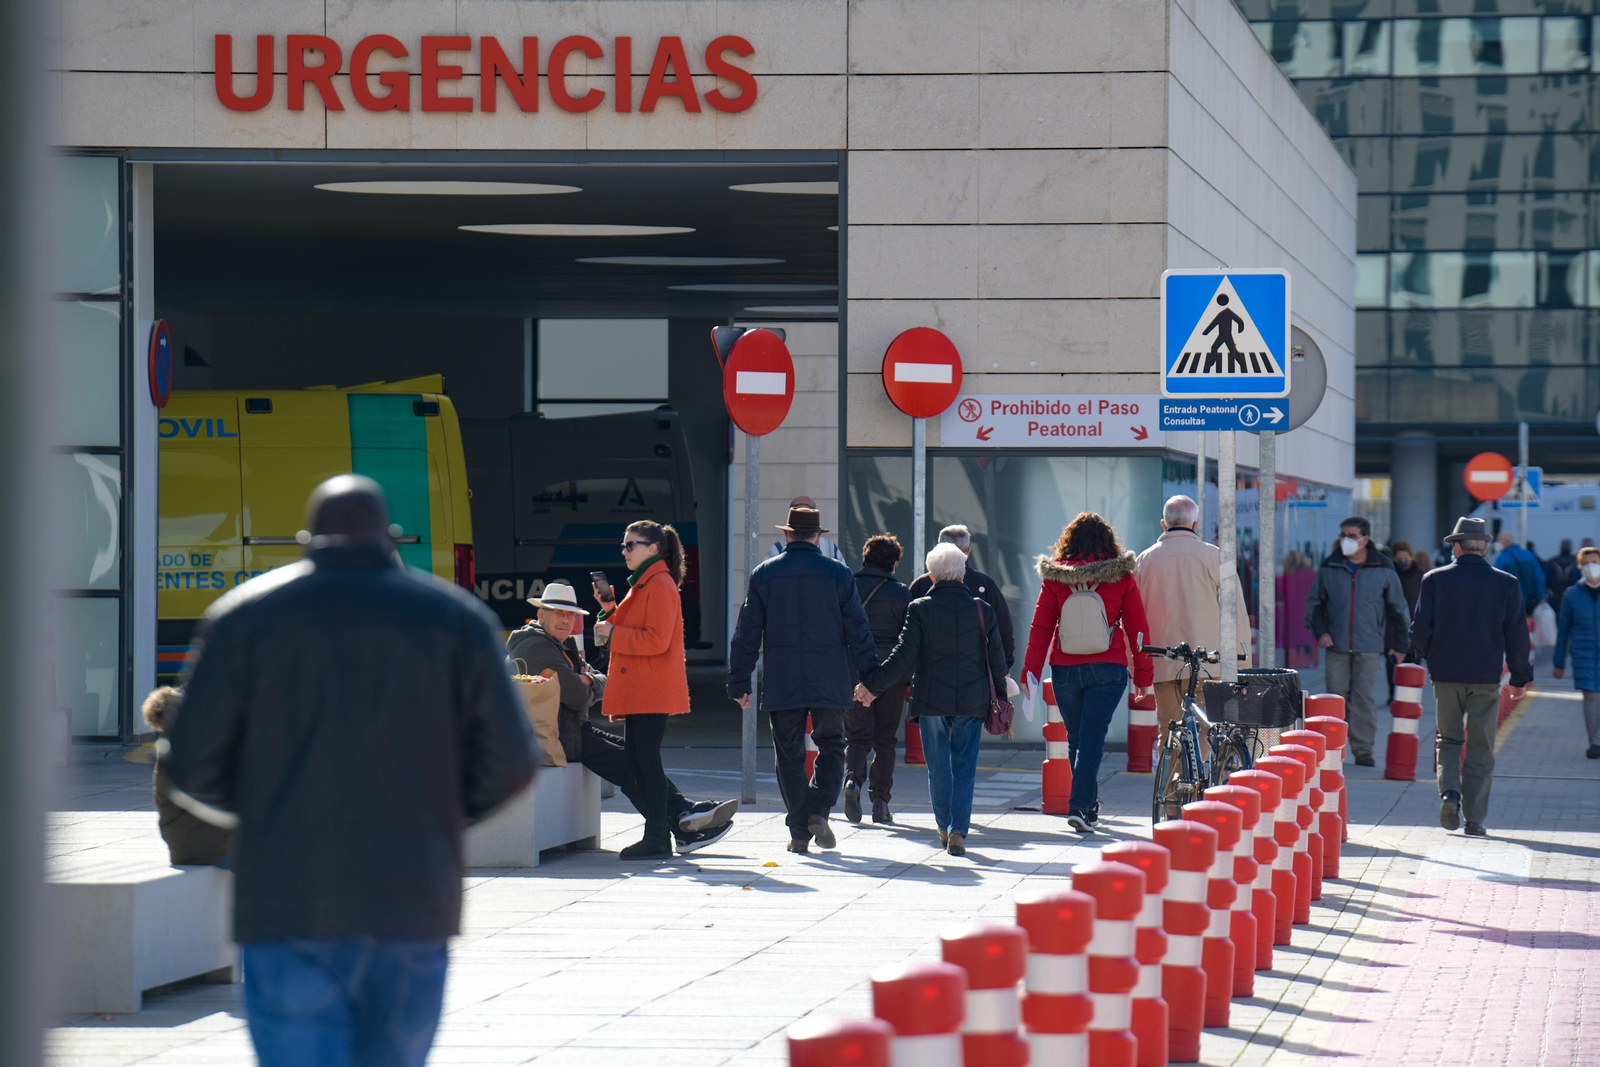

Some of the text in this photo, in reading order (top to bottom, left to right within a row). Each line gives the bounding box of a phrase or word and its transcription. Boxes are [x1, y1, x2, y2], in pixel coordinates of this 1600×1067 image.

[214, 34, 758, 113] URGENCIAS
[991, 400, 1139, 415] Prohibido el Paso
[1163, 404, 1238, 414] Entrada Peatonal
[1028, 421, 1102, 436] Peatonal
[1163, 417, 1206, 425] Consultas
[158, 553, 212, 567] DO DE
[474, 578, 571, 600] NCIA
